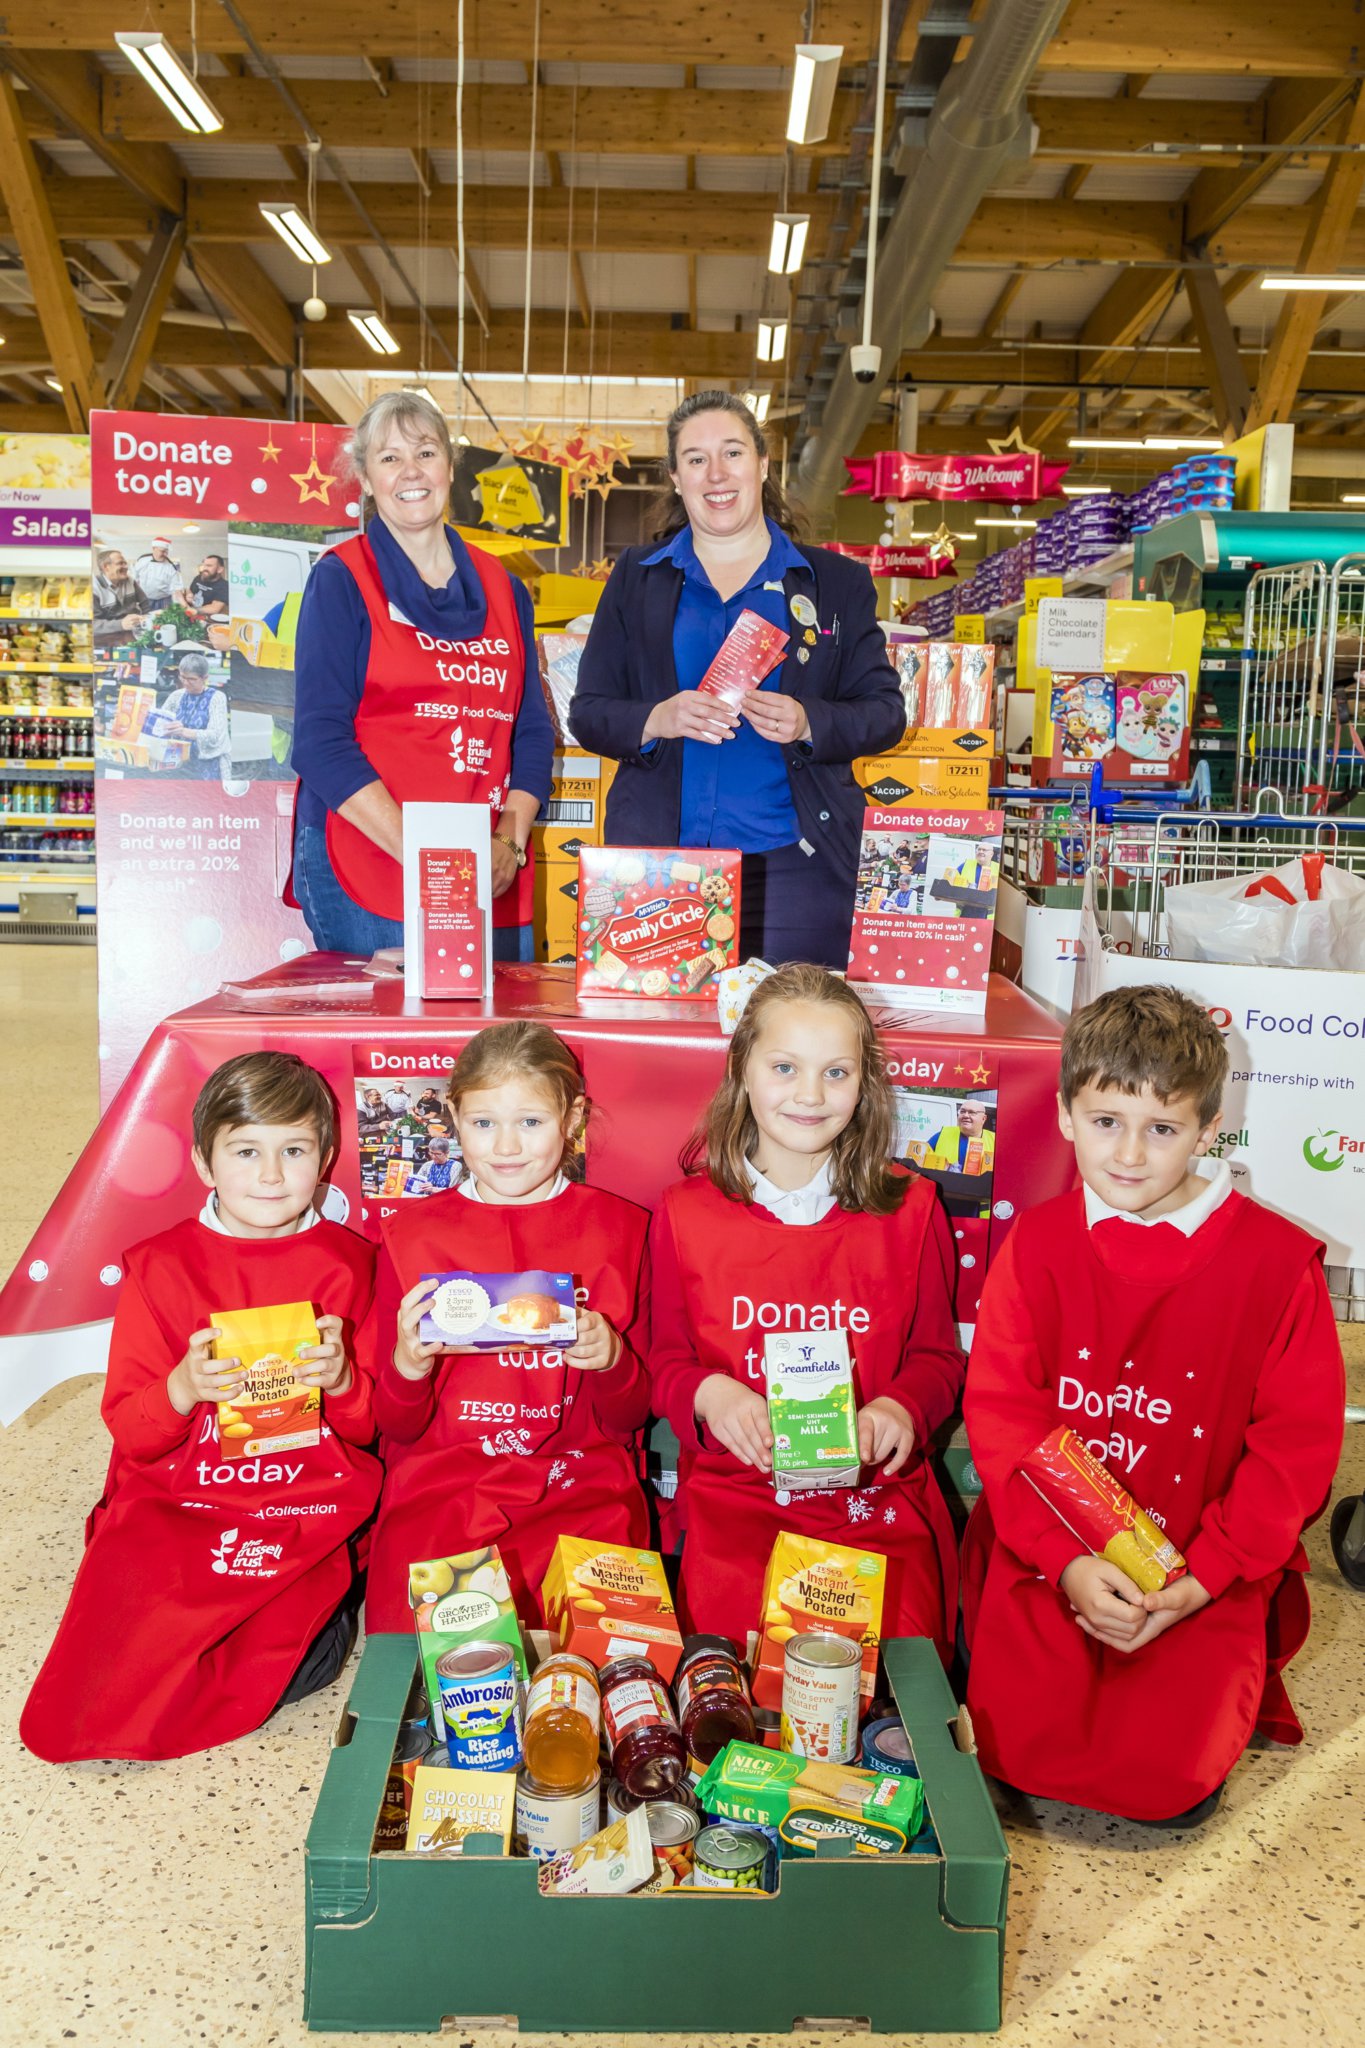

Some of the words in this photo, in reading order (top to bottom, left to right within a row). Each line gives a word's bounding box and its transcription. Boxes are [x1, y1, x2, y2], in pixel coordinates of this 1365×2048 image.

[113, 431, 233, 466] Donate
[900, 464, 962, 491] Everyone's
[964, 464, 1025, 488] Welcome
[115, 469, 210, 504] today
[483, 477, 503, 489] Black
[507, 482, 529, 496] Friday
[12, 516, 89, 538] Salads
[884, 553, 927, 568] Welcome
[1049, 608, 1067, 617] Milk
[1048, 618, 1098, 628] Chocolate
[1048, 628, 1097, 639] Calendars
[415, 631, 510, 656] Donate
[436, 659, 507, 692] today
[414, 703, 459, 716] TESCO
[463, 706, 485, 718] Food
[468, 738, 485, 747] the
[949, 766, 980, 775] 17211
[561, 781, 592, 790] 17211
[949, 786, 981, 799] Selection
[120, 813, 186, 829] Donate
[192, 816, 214, 829] an
[219, 813, 260, 829] item
[873, 812, 924, 827] Donate
[928, 815, 969, 831] today
[120, 836, 154, 850] and
[160, 836, 201, 850] we'll
[208, 835, 241, 850] add
[121, 858, 142, 871] an
[150, 858, 195, 871] extra
[201, 856, 240, 871] 20%
[609, 919, 660, 948] Family
[659, 904, 705, 930] Circle
[863, 918, 892, 926] Donate
[906, 920, 925, 928] item
[928, 922, 943, 930] and
[946, 923, 965, 931] we'll
[862, 928, 877, 936] add
[891, 930, 912, 938] extra
[914, 931, 932, 939] 20%
[934, 932, 942, 940] in
[1246, 1009, 1314, 1034] Food
[371, 1052, 456, 1069] Donate
[886, 1058, 944, 1082] oday
[1232, 1071, 1319, 1089] partnership
[1324, 1076, 1355, 1090] with
[448, 1304, 472, 1312] Sponge
[732, 1296, 870, 1333] Donate
[250, 1364, 288, 1379] Instant
[777, 1361, 840, 1376] Creamfields
[244, 1375, 295, 1393] Mashed
[251, 1388, 289, 1402] Potato
[460, 1400, 515, 1417] TESCO
[520, 1405, 548, 1419] Food
[788, 1412, 838, 1420] SEMI-SKIMMED
[800, 1425, 829, 1435] MILK
[792, 1460, 808, 1468] pints
[1075, 1439, 1122, 1491] DIGESTIVE
[197, 1460, 304, 1485] today
[792, 1493, 805, 1502] Stop
[806, 1491, 816, 1499] UK
[265, 1503, 337, 1518] Collection
[242, 1539, 262, 1548] the
[237, 1544, 283, 1560] trussell
[233, 1555, 263, 1568] trust
[595, 1559, 634, 1574] Instant
[246, 1568, 256, 1576] UK
[591, 1567, 644, 1585] Mashed
[816, 1566, 843, 1577] TESCO
[600, 1578, 640, 1592] Potato
[807, 1570, 848, 1590] Instant
[799, 1582, 855, 1606] Mashed
[804, 1598, 846, 1617] Potato
[441, 1610, 490, 1626] HARVEST
[695, 1670, 732, 1680] Strawberry
[794, 1665, 815, 1674] TESCO
[697, 1674, 714, 1684] Jam
[812, 1680, 837, 1690] Value
[442, 1682, 514, 1711] Ambrosia
[788, 1696, 818, 1712] custard
[798, 1690, 806, 1699] to
[808, 1693, 834, 1704] serve
[468, 1738, 500, 1752] Rice
[457, 1744, 514, 1766] Pudding
[731, 1756, 774, 1772] NICE
[870, 1755, 902, 1774] TESCO
[424, 1790, 504, 1808] CHOCOLAT
[423, 1806, 501, 1826] PATISSIER
[526, 1810, 550, 1822] Value
[716, 1800, 770, 1826] NICE
[375, 1820, 409, 1837] violi
[834, 1818, 868, 1831] TESCO
[701, 1874, 719, 1885] TESCO
